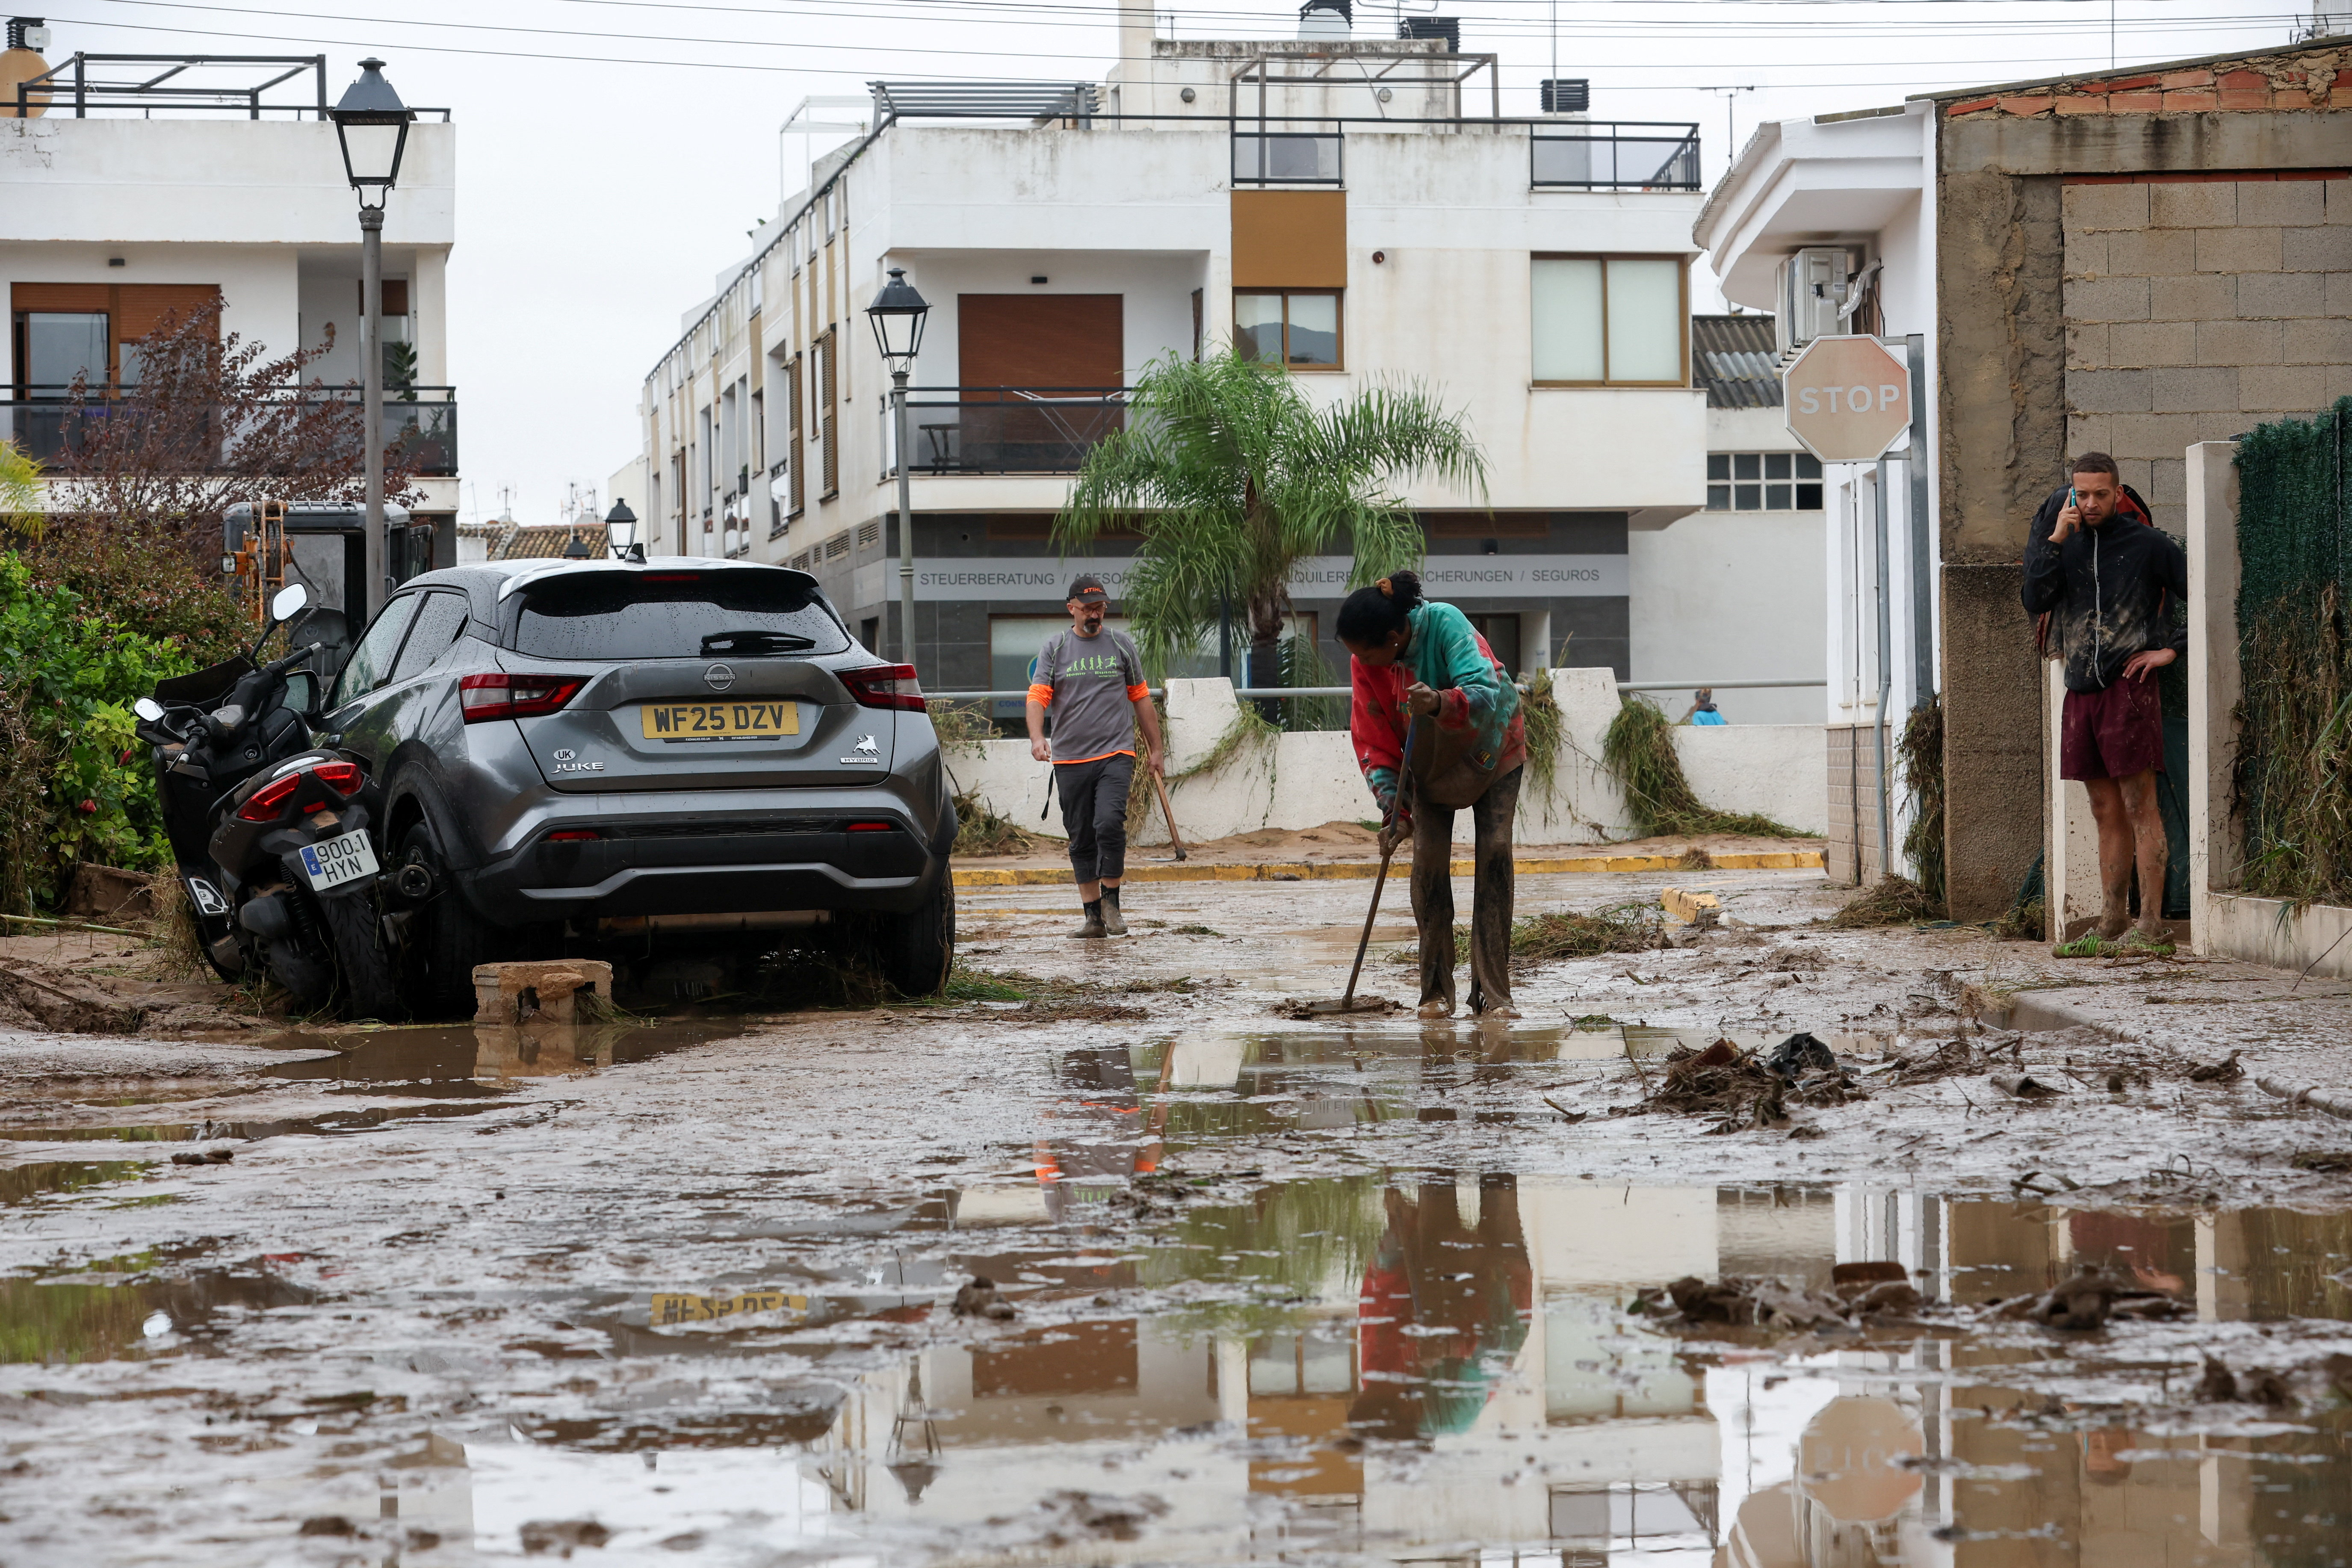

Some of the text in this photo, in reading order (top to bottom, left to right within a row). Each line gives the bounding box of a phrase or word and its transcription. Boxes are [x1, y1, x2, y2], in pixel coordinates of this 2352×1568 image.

[1799, 384, 1900, 414] STOP
[920, 573, 1054, 585] STEUERBERATUNG
[1063, 573, 1067, 585] /
[1520, 570, 1525, 582] /
[1532, 570, 1599, 581] SEGUROS
[653, 705, 783, 732] WF25 DZV
[551, 762, 604, 774] JUKE
[558, 750, 571, 759] UK
[316, 834, 366, 863] 9001
[323, 856, 363, 883] HYN
